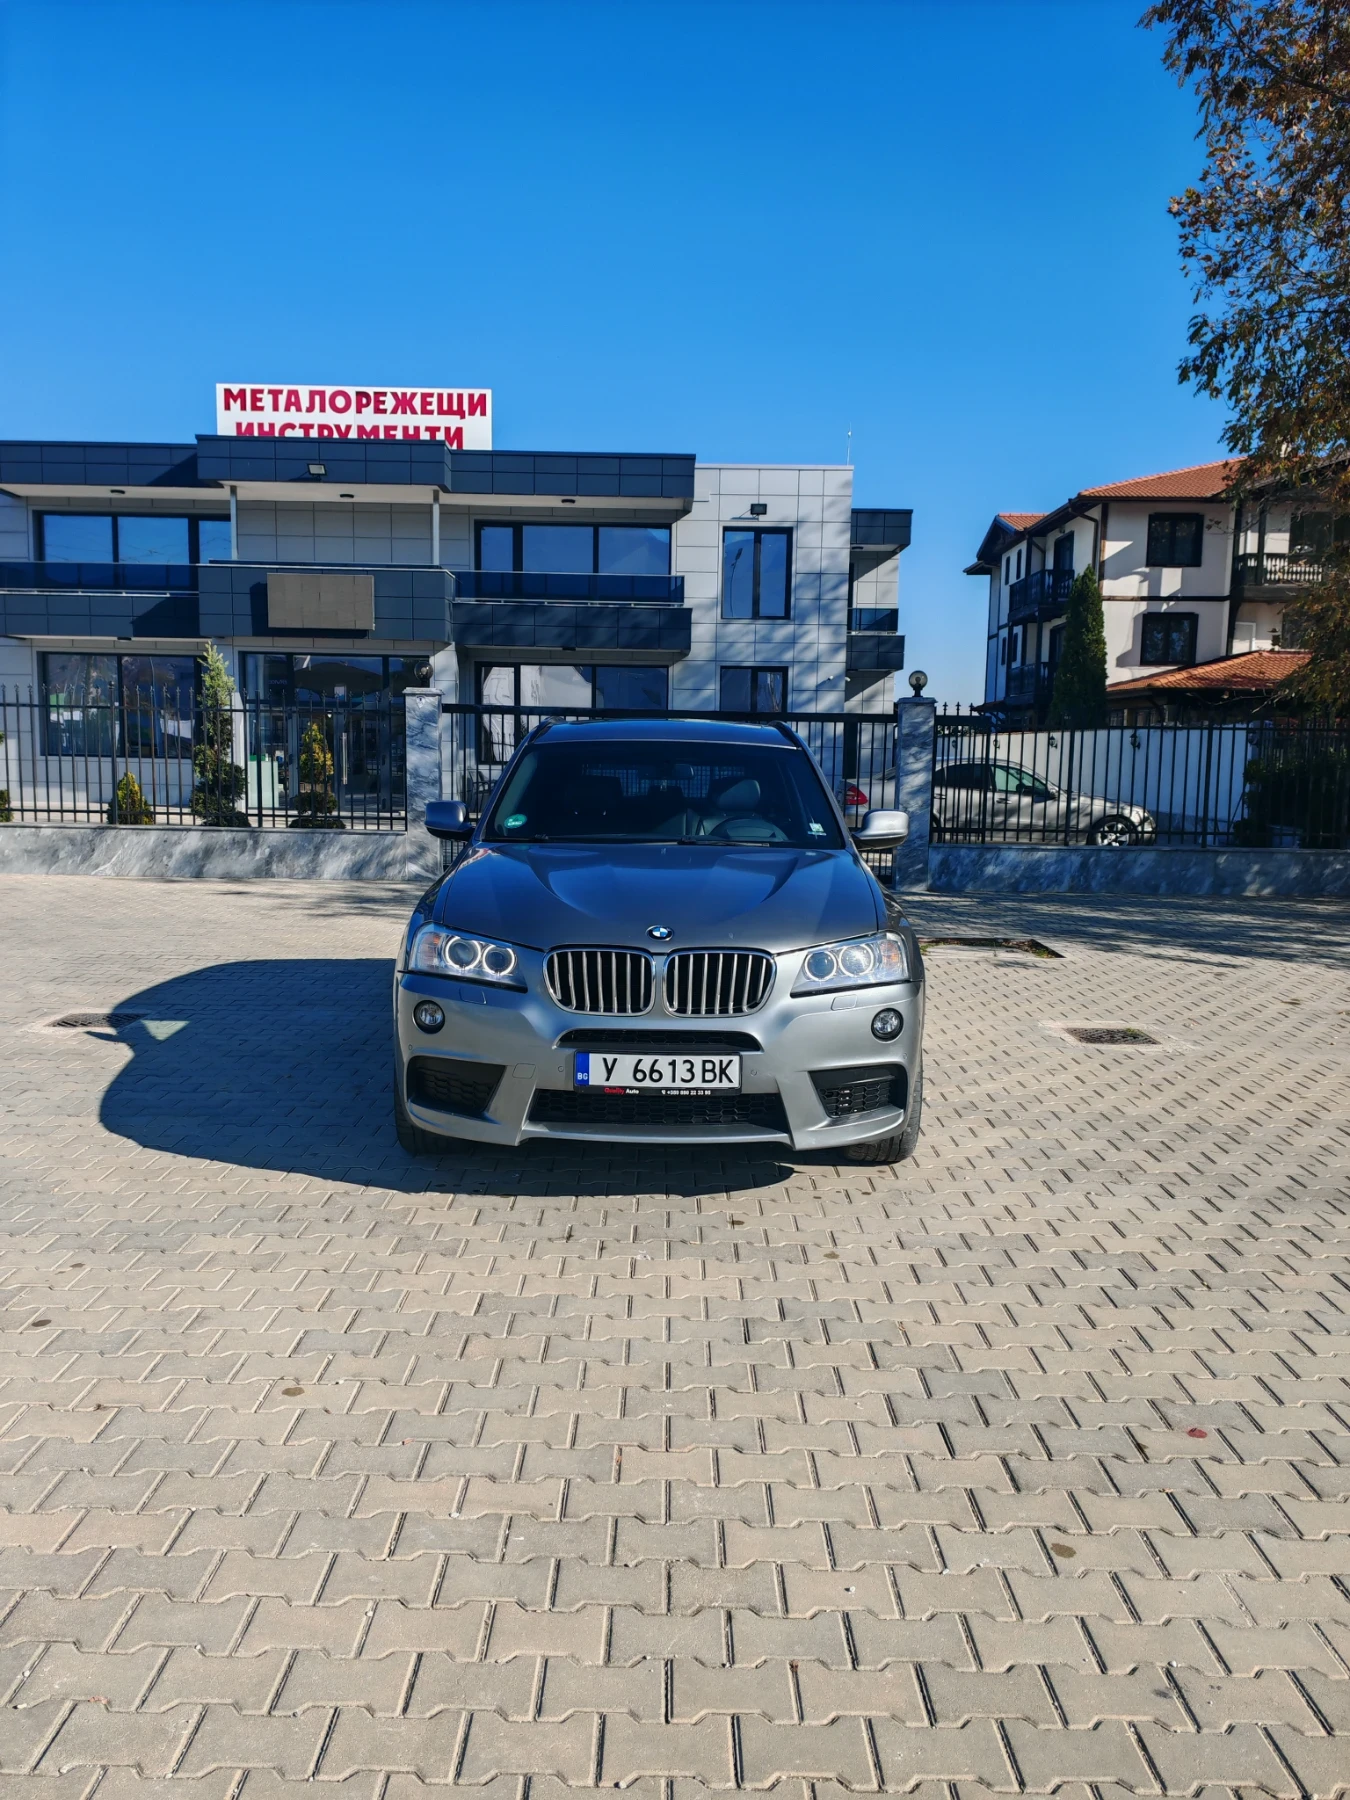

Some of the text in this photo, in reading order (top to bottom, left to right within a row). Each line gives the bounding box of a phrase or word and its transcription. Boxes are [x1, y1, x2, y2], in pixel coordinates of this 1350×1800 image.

[224, 387, 487, 419] МЕТАЛОРЕЖЕЩИ
[577, 1072, 588, 1080] BG
[625, 1087, 640, 1095] Auto
